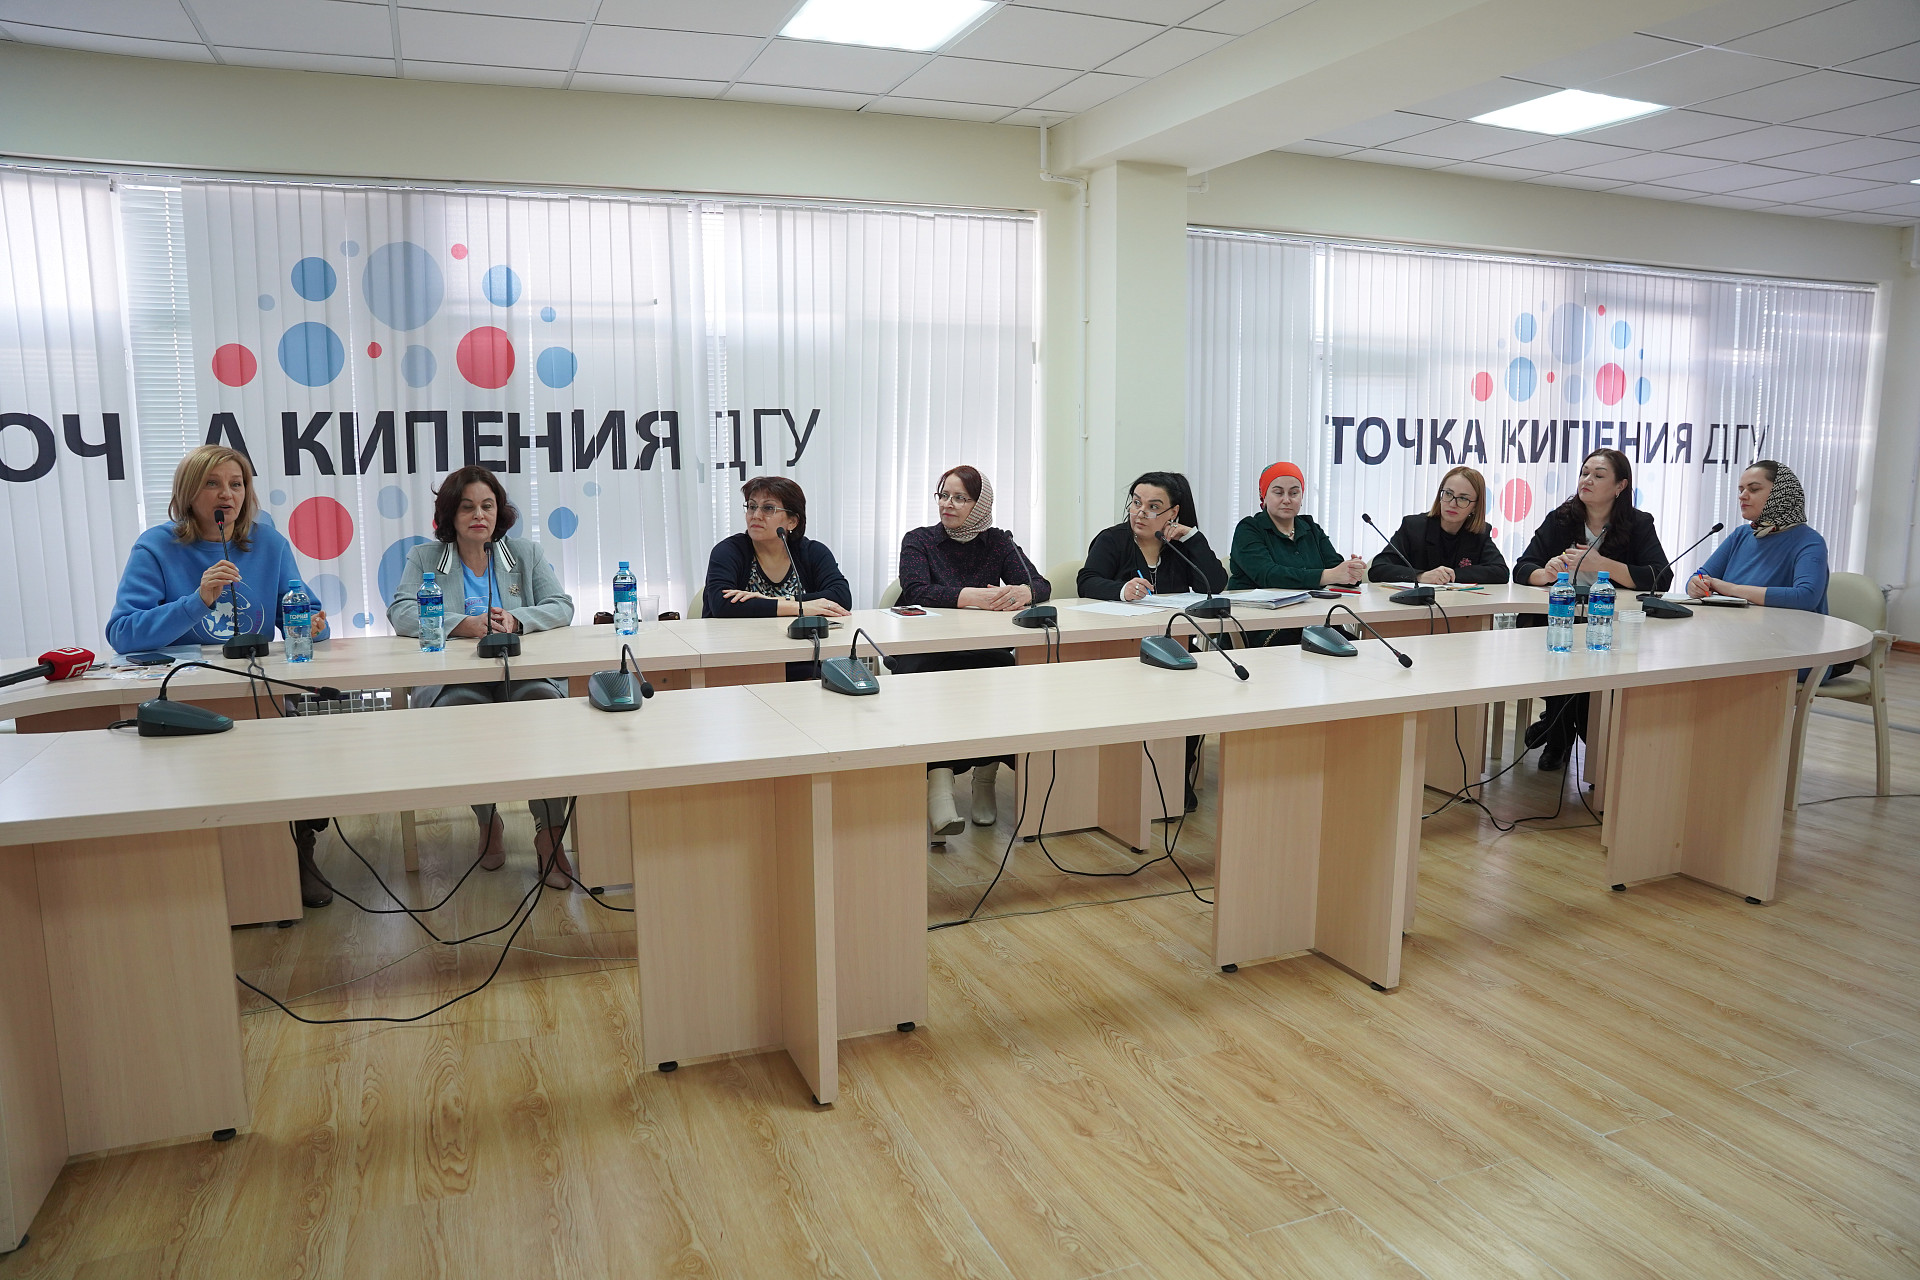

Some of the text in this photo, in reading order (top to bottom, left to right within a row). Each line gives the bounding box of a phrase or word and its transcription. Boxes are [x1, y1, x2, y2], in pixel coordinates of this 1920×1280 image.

[282, 409, 681, 475] КИПЕНИЯ
[1325, 414, 1770, 474] ТОЧКА КИПЕНИЯ ДГУ
